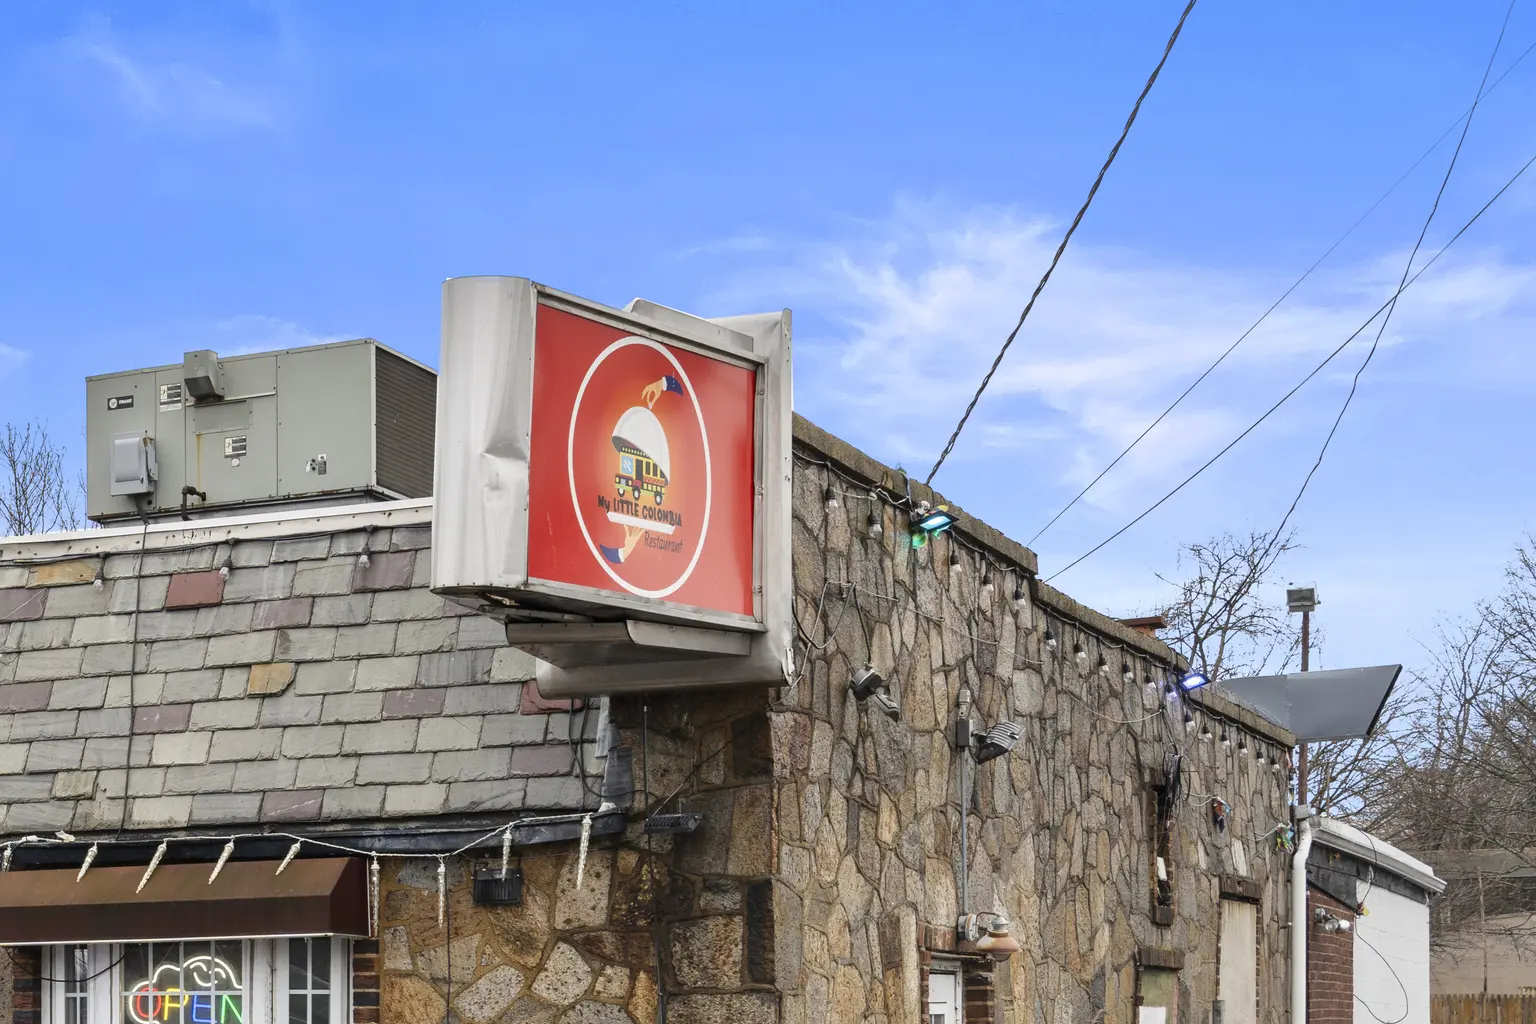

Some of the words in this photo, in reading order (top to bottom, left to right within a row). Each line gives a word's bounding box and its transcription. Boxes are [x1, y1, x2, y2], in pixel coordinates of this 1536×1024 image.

[598, 495, 611, 513] My
[614, 498, 639, 518] LITTLE
[642, 505, 682, 527] COLOMBIA
[644, 531, 683, 554] Restaurant
[135, 985, 243, 1024] OPEN
